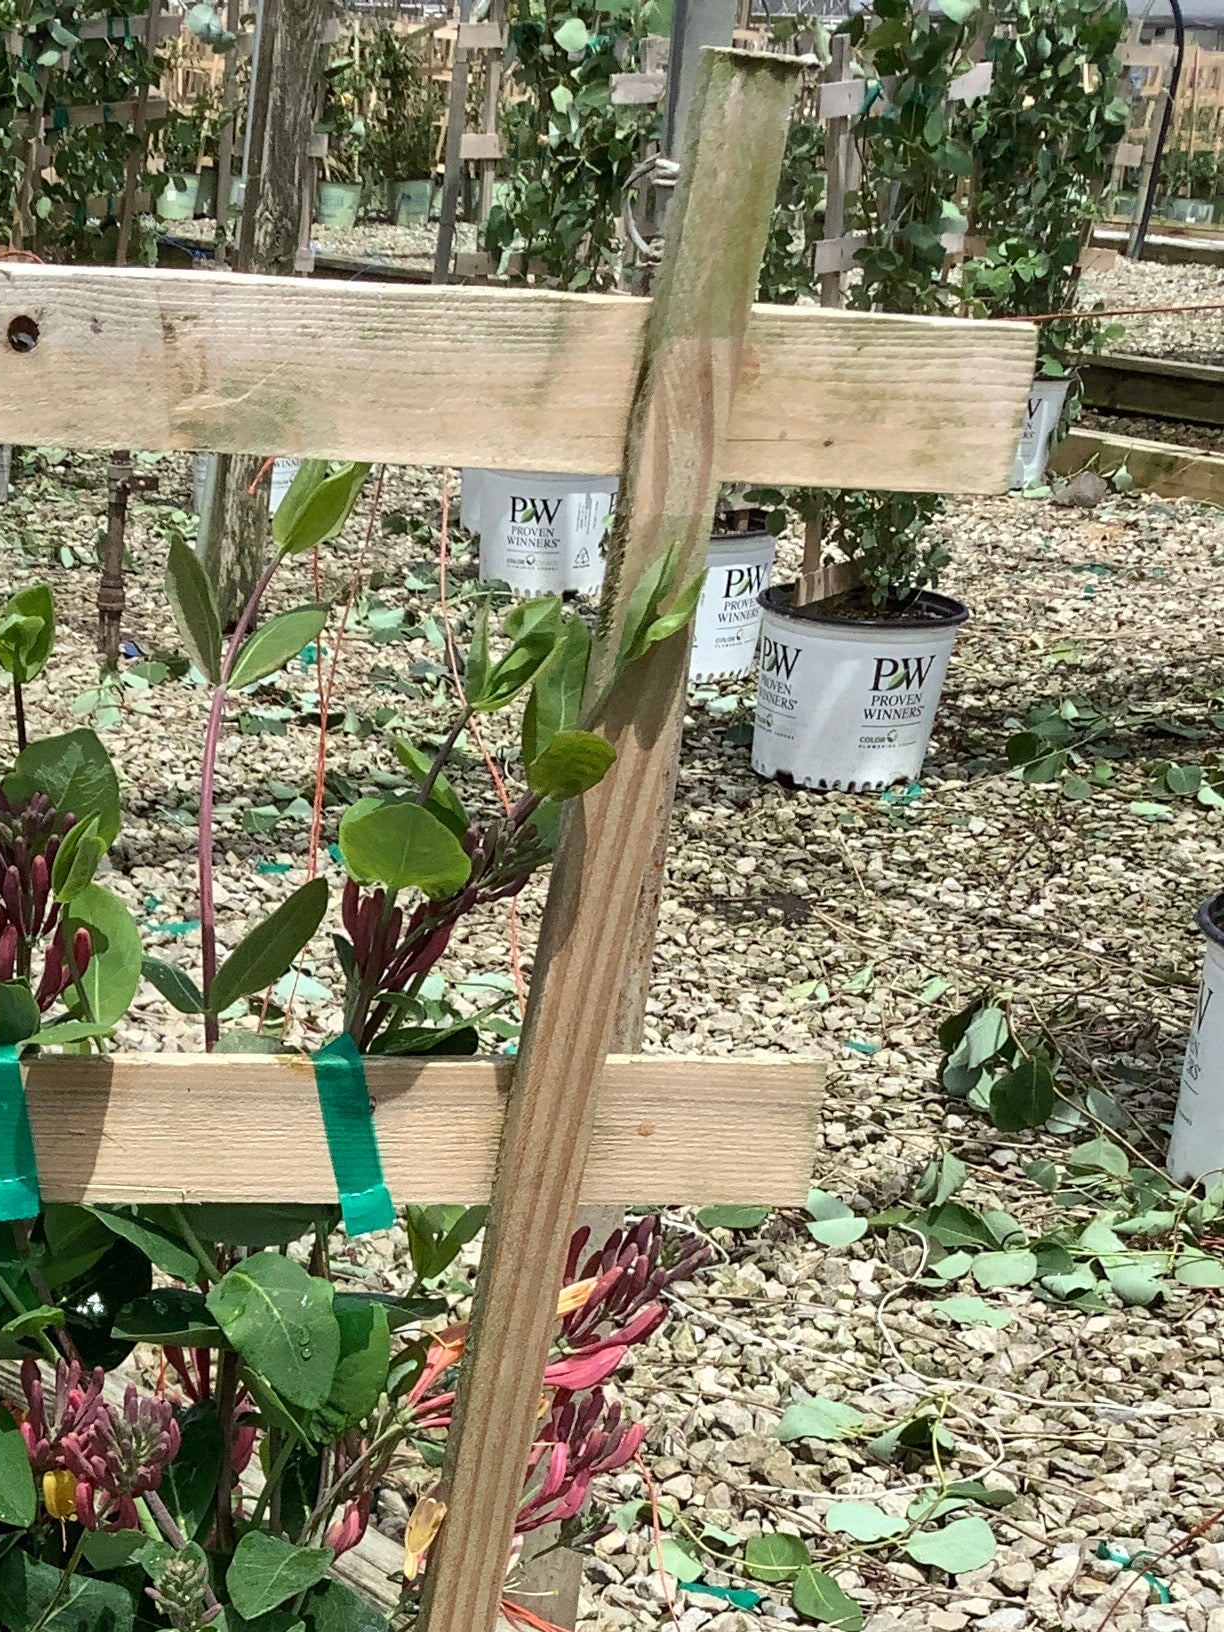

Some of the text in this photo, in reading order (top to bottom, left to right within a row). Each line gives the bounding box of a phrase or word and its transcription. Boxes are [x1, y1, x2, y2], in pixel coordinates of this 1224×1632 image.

[510, 496, 563, 525] PW
[511, 526, 555, 537] PROVEN
[507, 536, 558, 549] WINNERS
[722, 562, 769, 598] PW
[724, 599, 757, 611] PROVE
[762, 635, 803, 681] PW
[869, 654, 937, 692] PW
[870, 693, 923, 707] PROVEN
[863, 706, 922, 721] WINNERS
